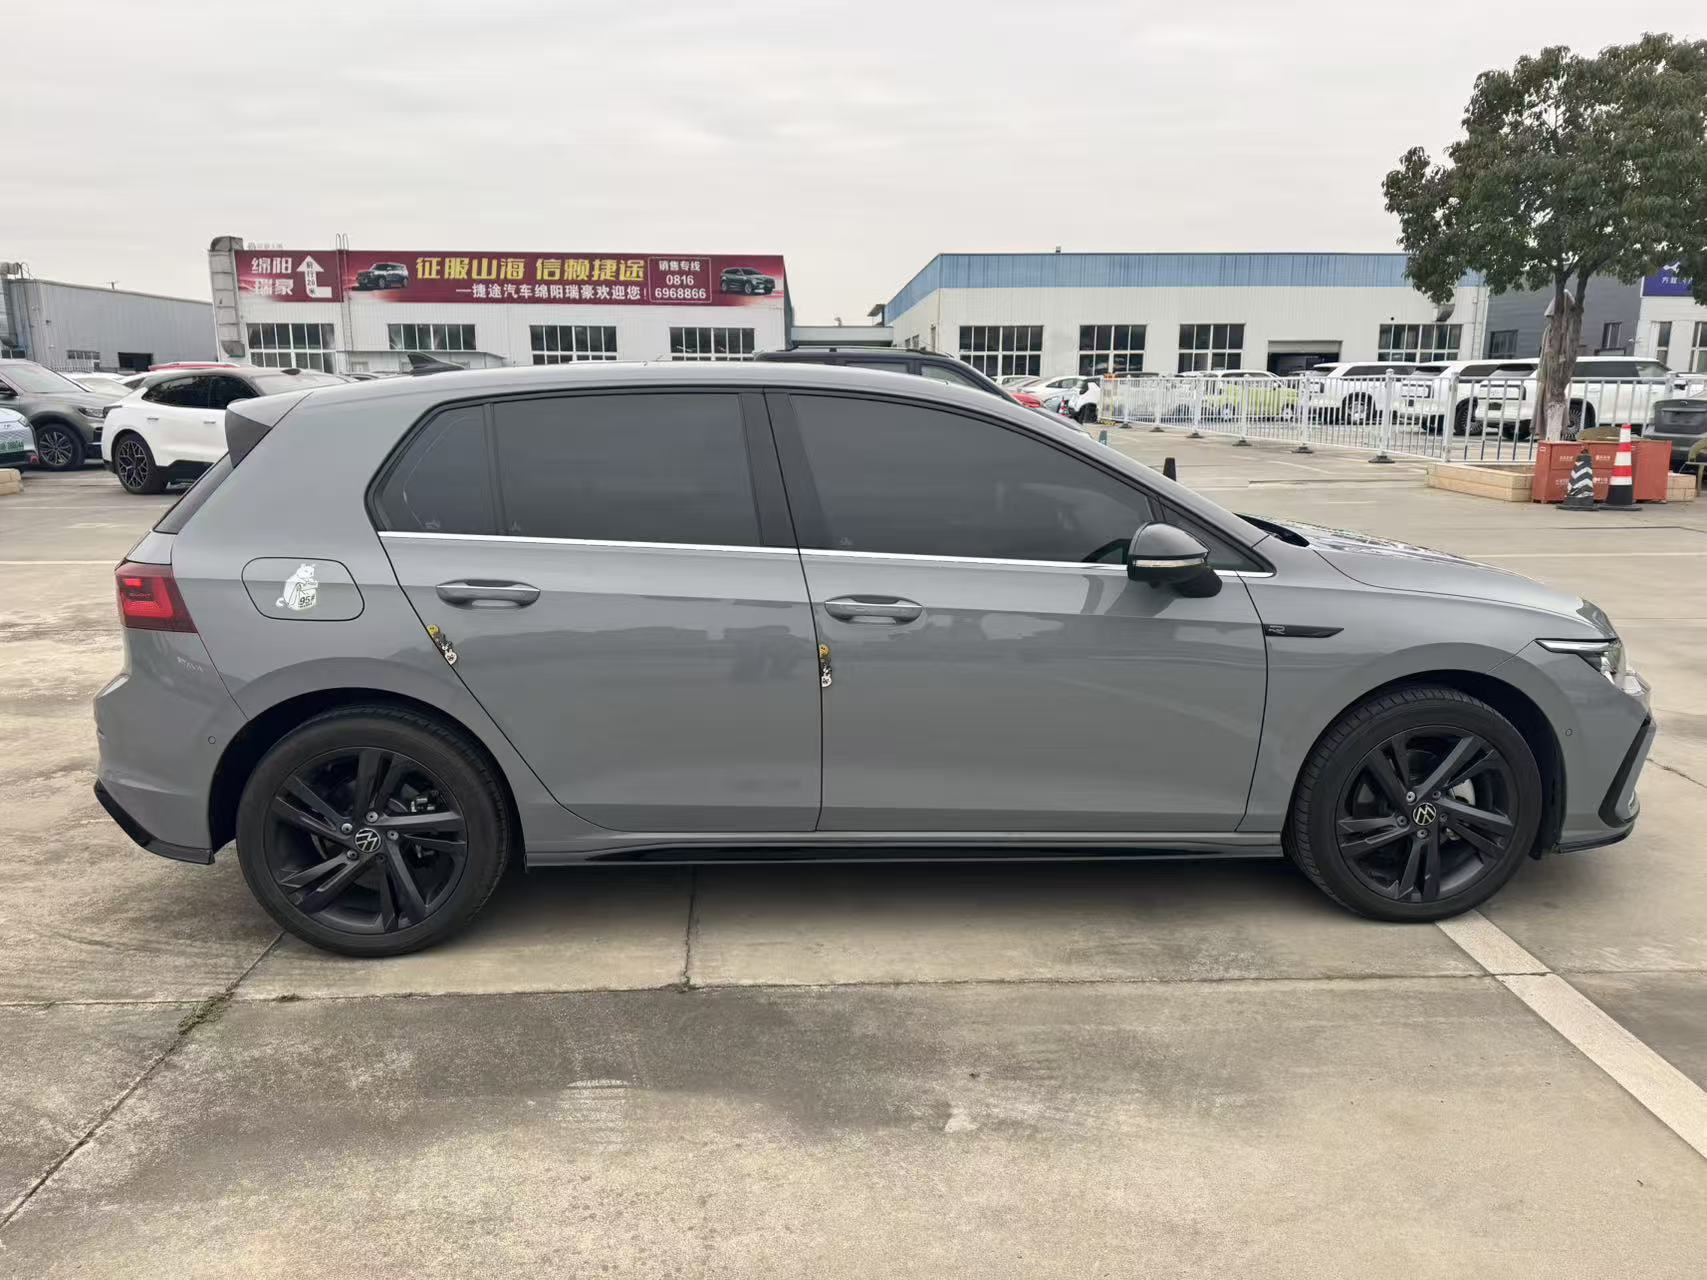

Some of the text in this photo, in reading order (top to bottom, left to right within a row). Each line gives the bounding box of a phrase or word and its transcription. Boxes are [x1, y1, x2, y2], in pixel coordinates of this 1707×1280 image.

[251, 257, 292, 274] 绵阳
[415, 257, 645, 282] 征服山海 信赖捷途
[658, 260, 701, 272] 销售专线
[254, 278, 294, 296] 瑞豪
[666, 274, 695, 286] 0816
[655, 287, 707, 299] 6968866
